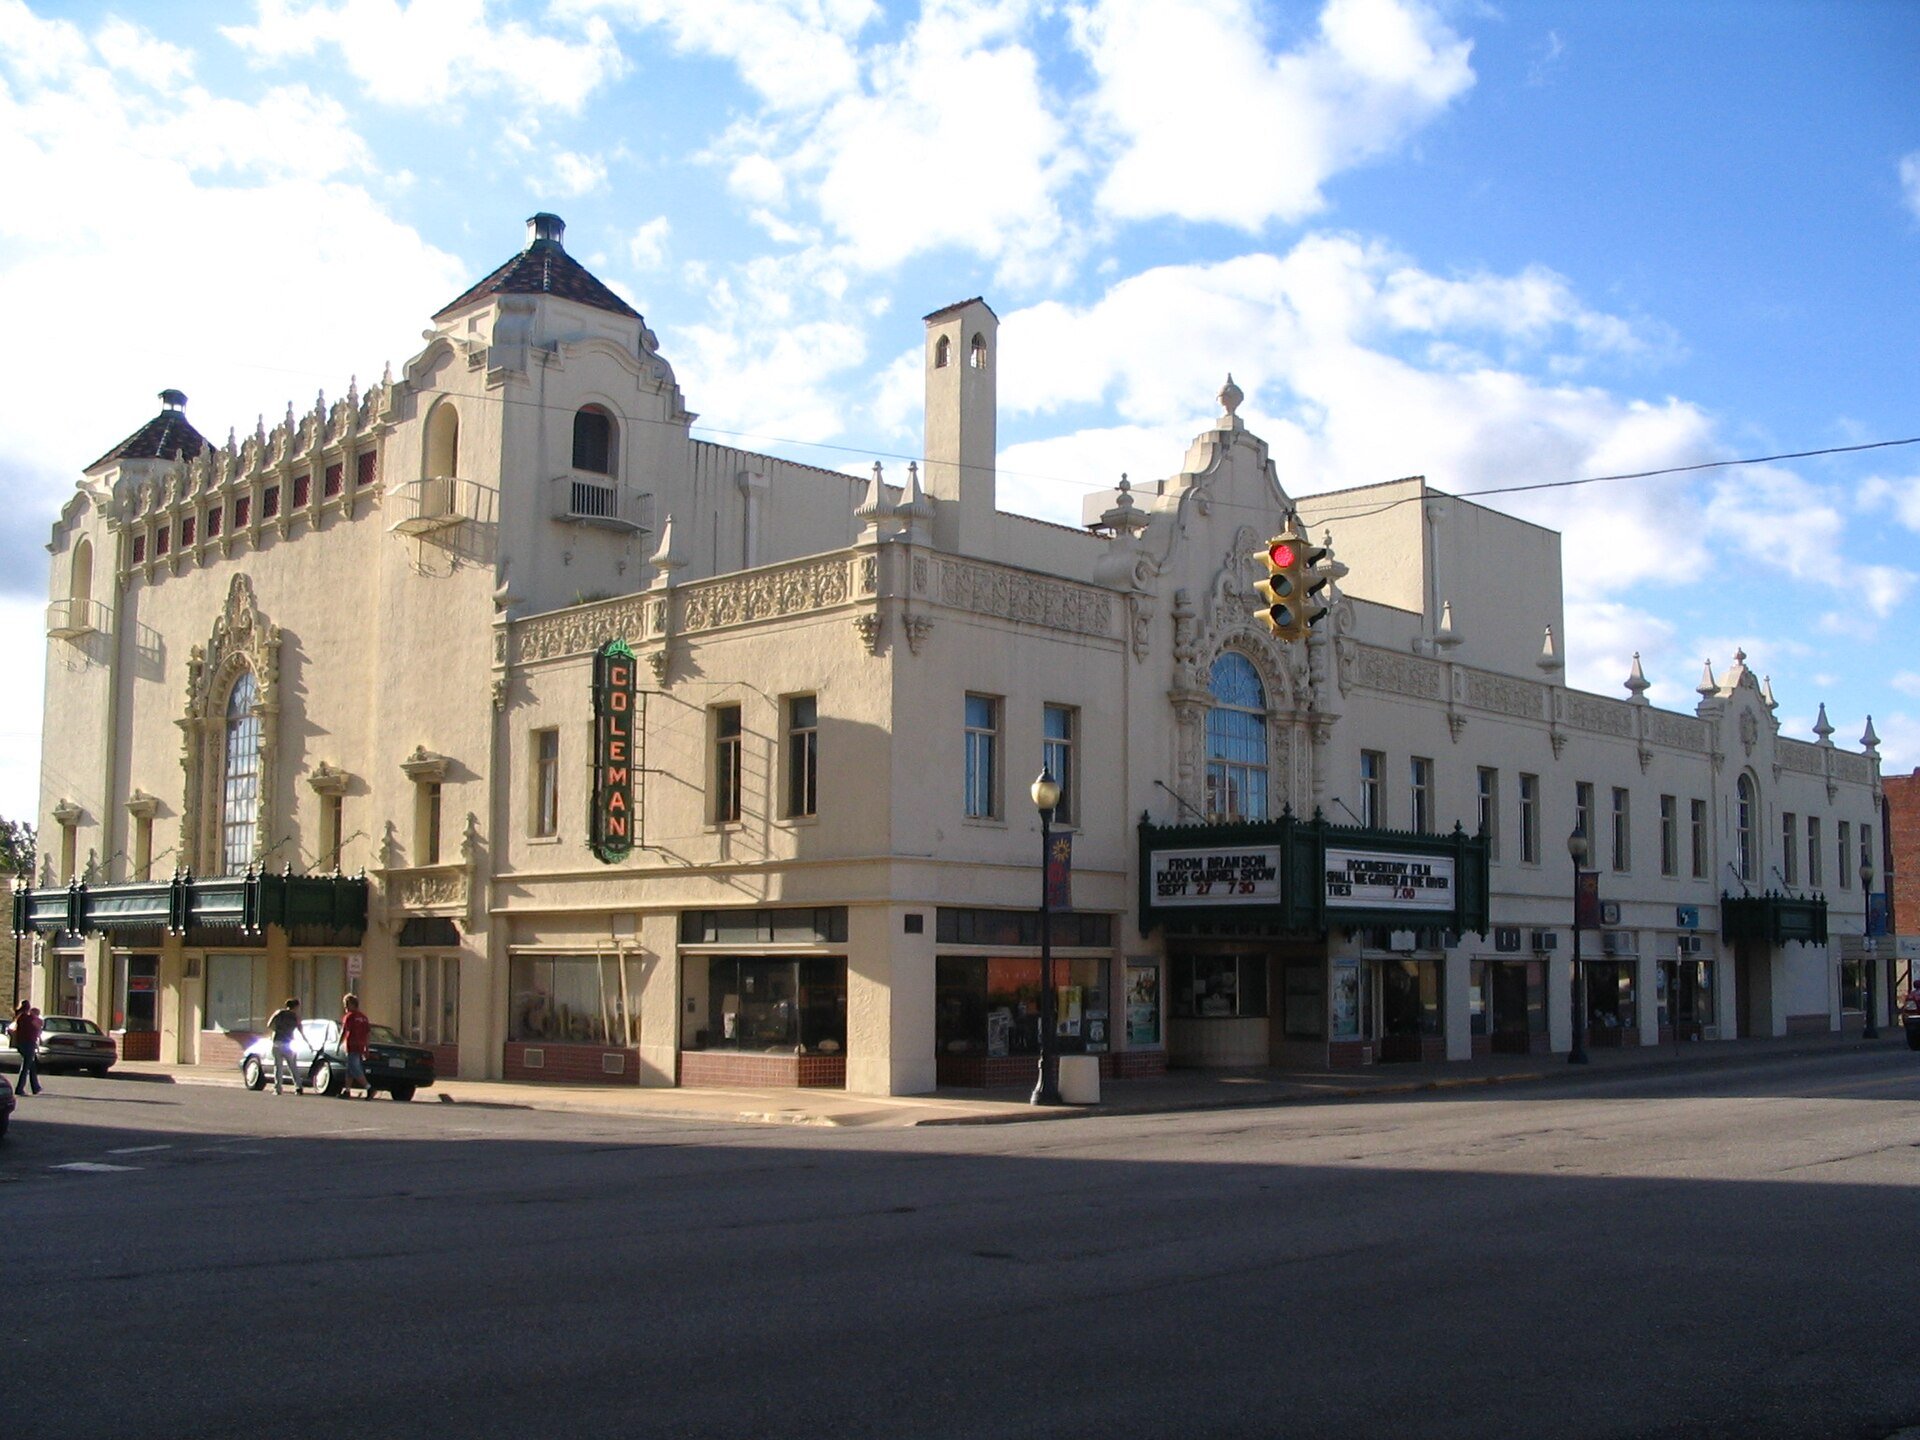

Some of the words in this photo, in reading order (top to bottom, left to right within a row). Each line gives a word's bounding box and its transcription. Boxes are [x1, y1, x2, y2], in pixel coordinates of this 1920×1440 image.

[608, 667, 628, 837] COLEMAN
[1169, 857, 1203, 871] FROM
[1208, 855, 1266, 869] BRANSON
[1347, 859, 1409, 874] DOCUMENTARY
[1411, 863, 1431, 876] FILM
[1157, 870, 1189, 883] DOUG
[1191, 869, 1239, 882] GABRIEL
[1240, 867, 1276, 881] SHOW
[1326, 871, 1353, 884] SHALL
[1354, 873, 1367, 885] WE
[1368, 874, 1399, 886] GATHER
[1410, 876, 1424, 888] THE
[1426, 877, 1449, 889] RIVER
[1158, 883, 1188, 896] SEPT
[1196, 883, 1213, 895] 27
[1328, 884, 1352, 897] TUES
